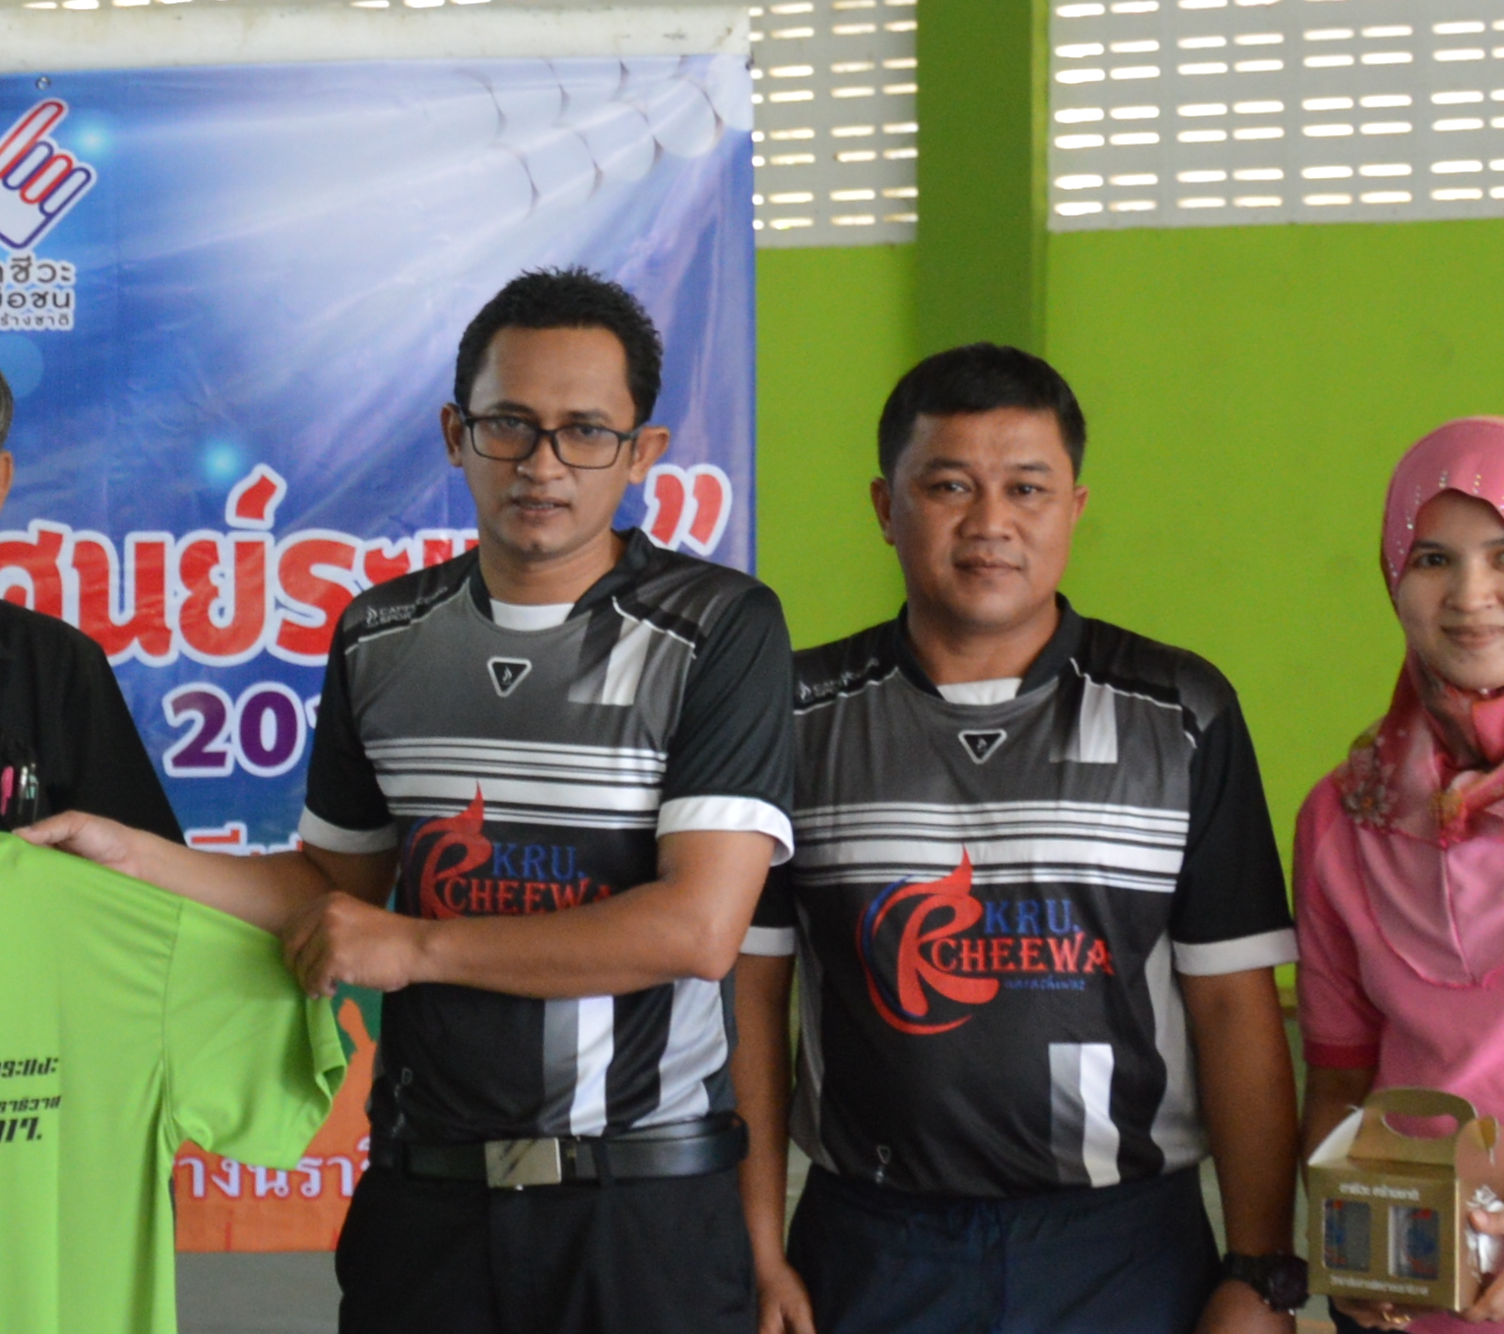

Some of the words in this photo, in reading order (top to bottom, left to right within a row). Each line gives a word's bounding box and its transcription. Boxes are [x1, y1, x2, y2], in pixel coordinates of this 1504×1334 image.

[168, 687, 320, 772] 20
[983, 899, 1081, 935] KRU.
[930, 931, 1116, 975] CHEEWA
